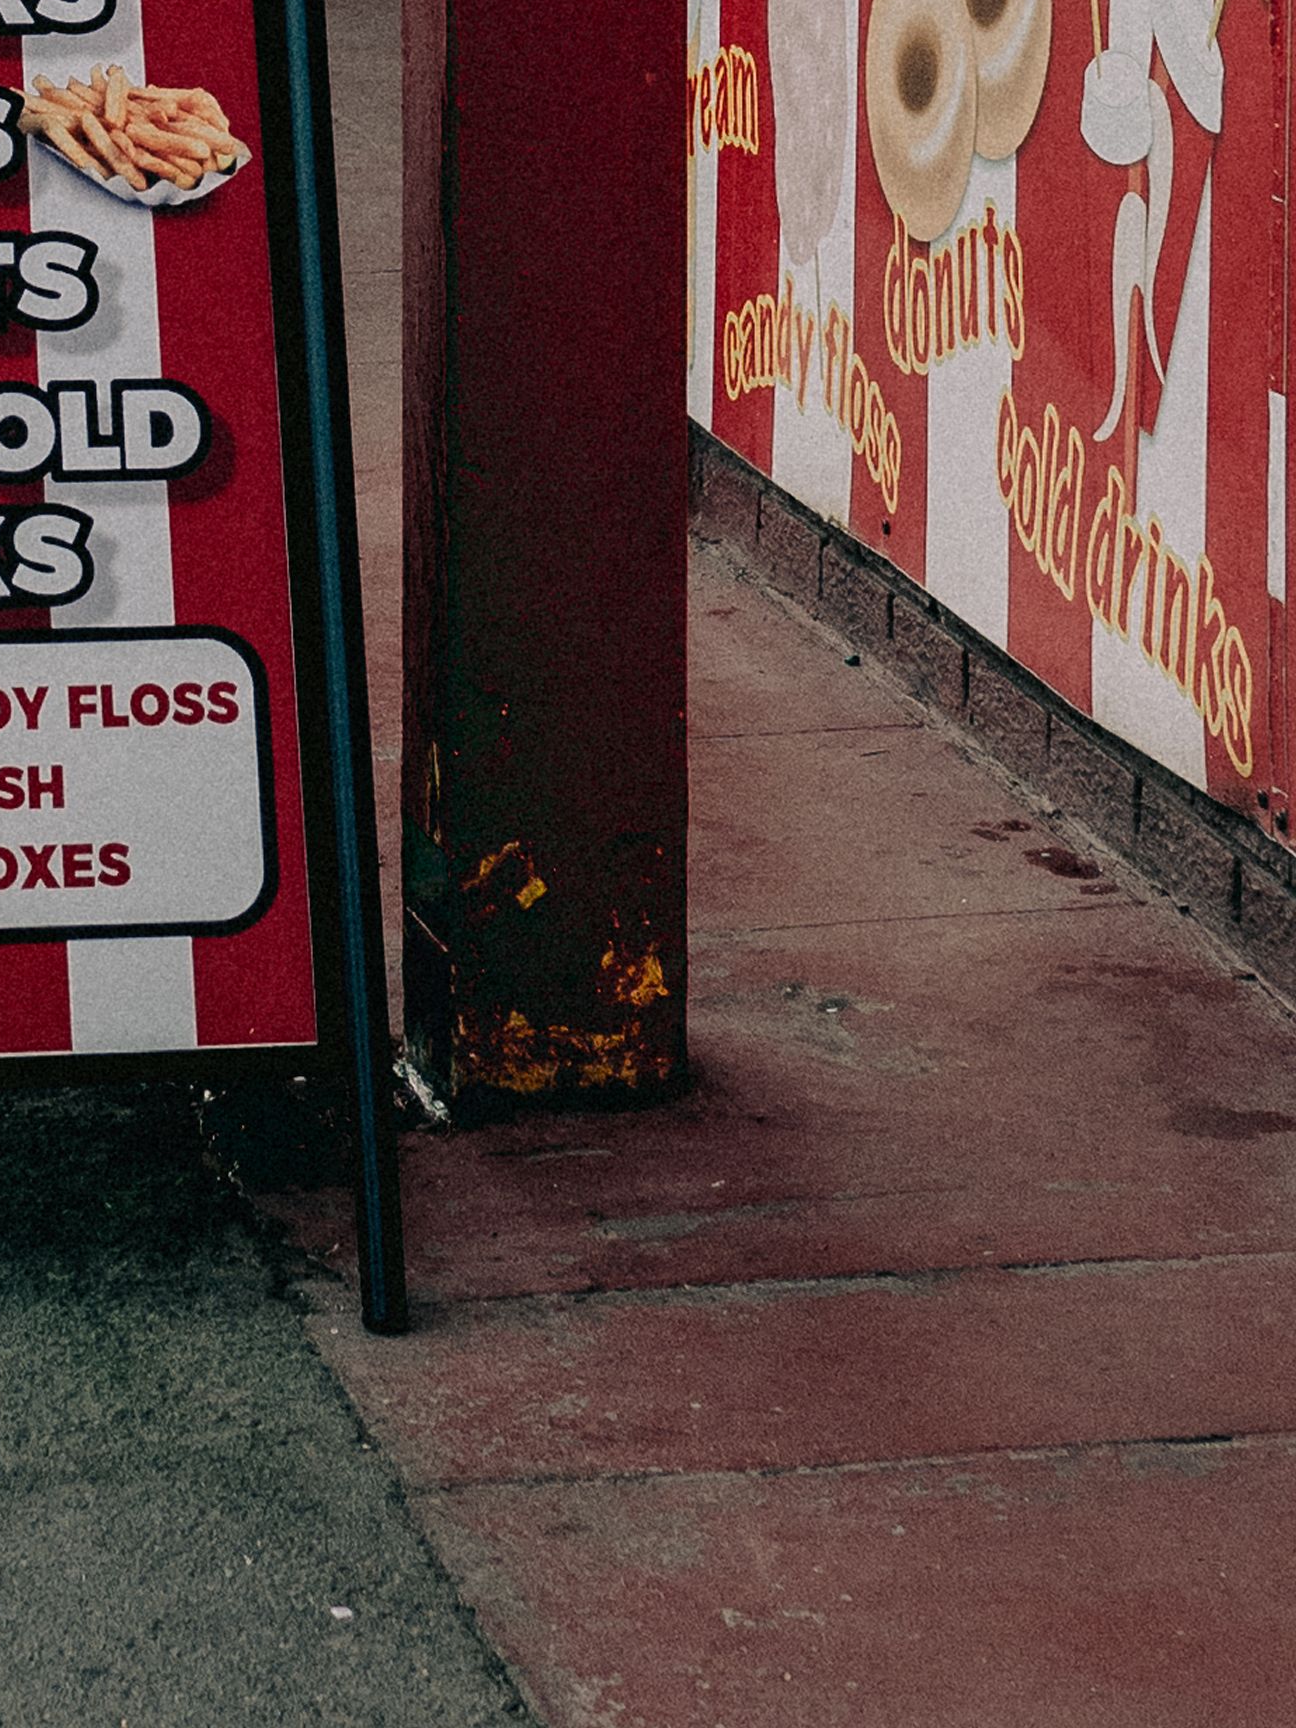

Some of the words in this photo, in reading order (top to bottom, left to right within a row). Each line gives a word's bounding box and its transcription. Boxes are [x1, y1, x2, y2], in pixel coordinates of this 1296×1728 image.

[723, 269, 812, 419] candy
[819, 296, 903, 518] floss
[883, 196, 1027, 380] donuts
[994, 387, 1079, 604] cold
[1086, 462, 1255, 780] drinks
[66, 680, 241, 730] FLOSS
